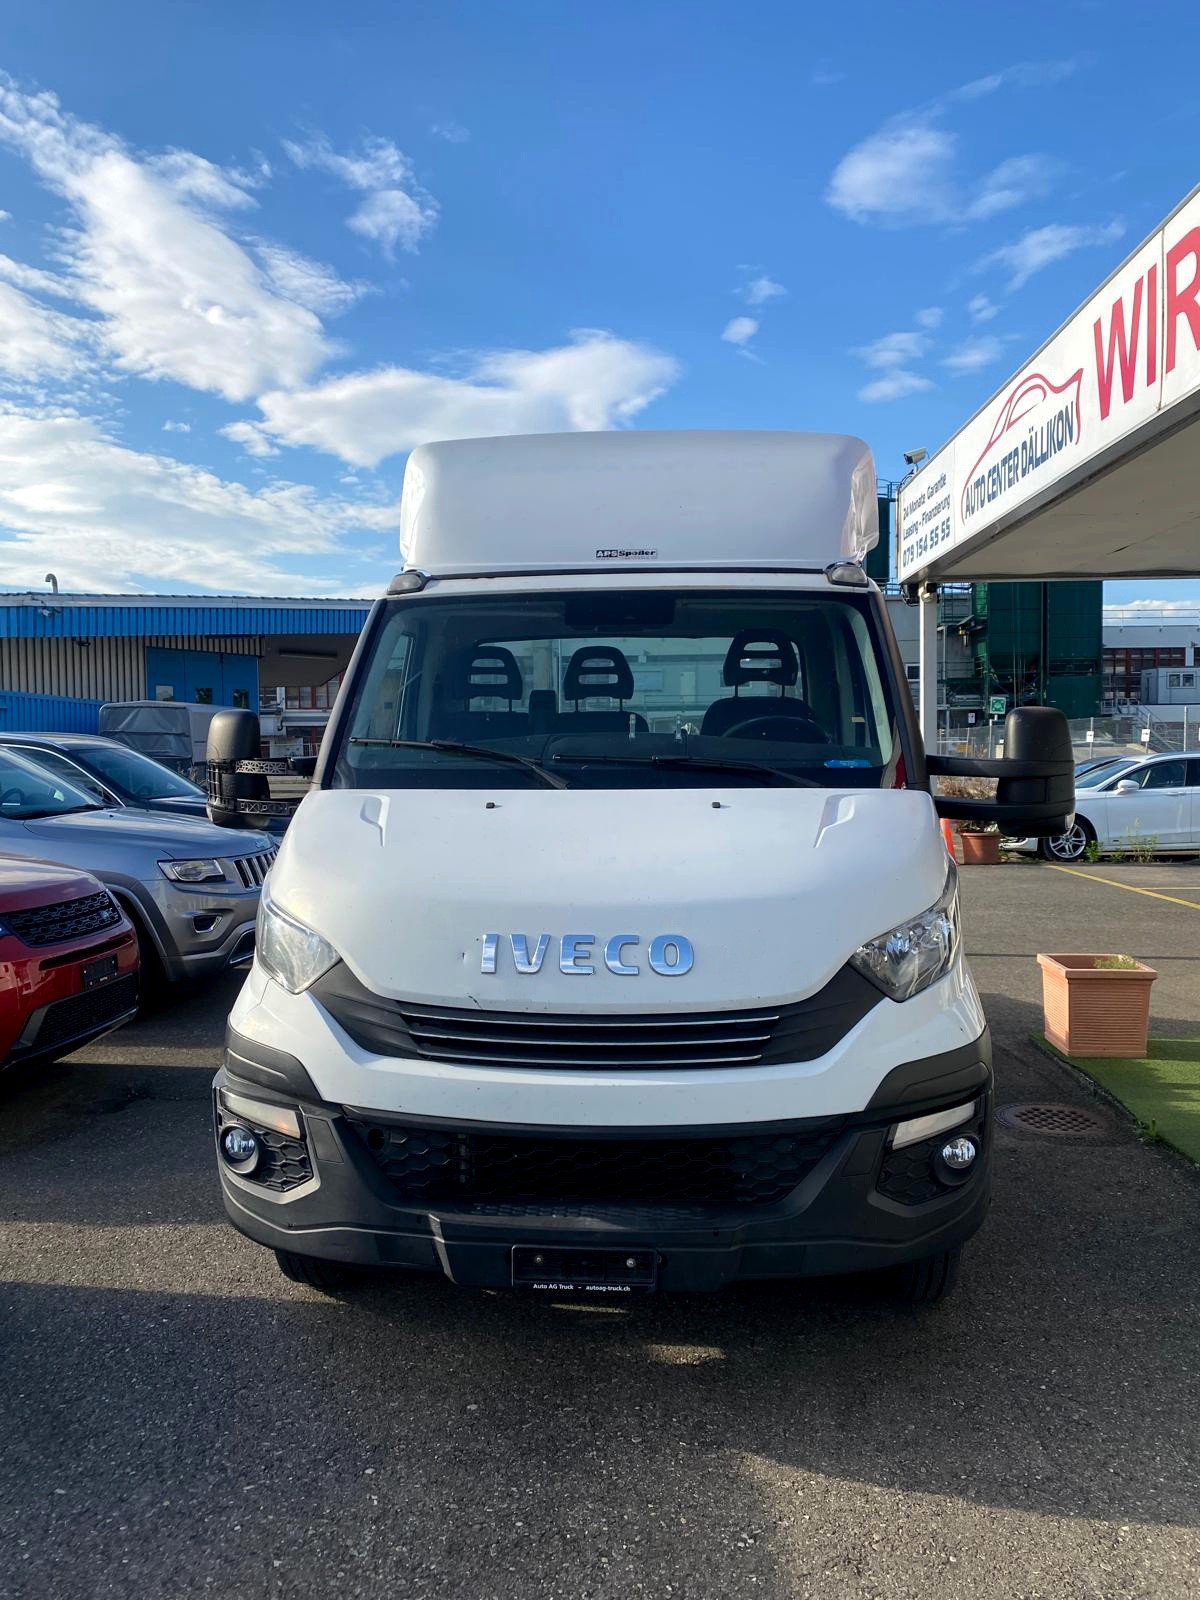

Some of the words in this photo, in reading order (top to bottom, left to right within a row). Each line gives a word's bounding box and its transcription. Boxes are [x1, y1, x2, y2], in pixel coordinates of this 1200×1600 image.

[965, 473, 985, 518] AUTO
[987, 450, 1019, 503] CENTER
[1021, 400, 1075, 479] DÄLLIKON
[909, 491, 926, 512] Monate
[927, 473, 946, 500] Garantie
[903, 521, 919, 541] Leasing
[922, 494, 951, 527] Finanzierung
[903, 544, 914, 568] 079
[916, 534, 928, 559] 154
[930, 525, 939, 550] 55
[941, 516, 951, 541] 55
[480, 933, 695, 977] IVECO
